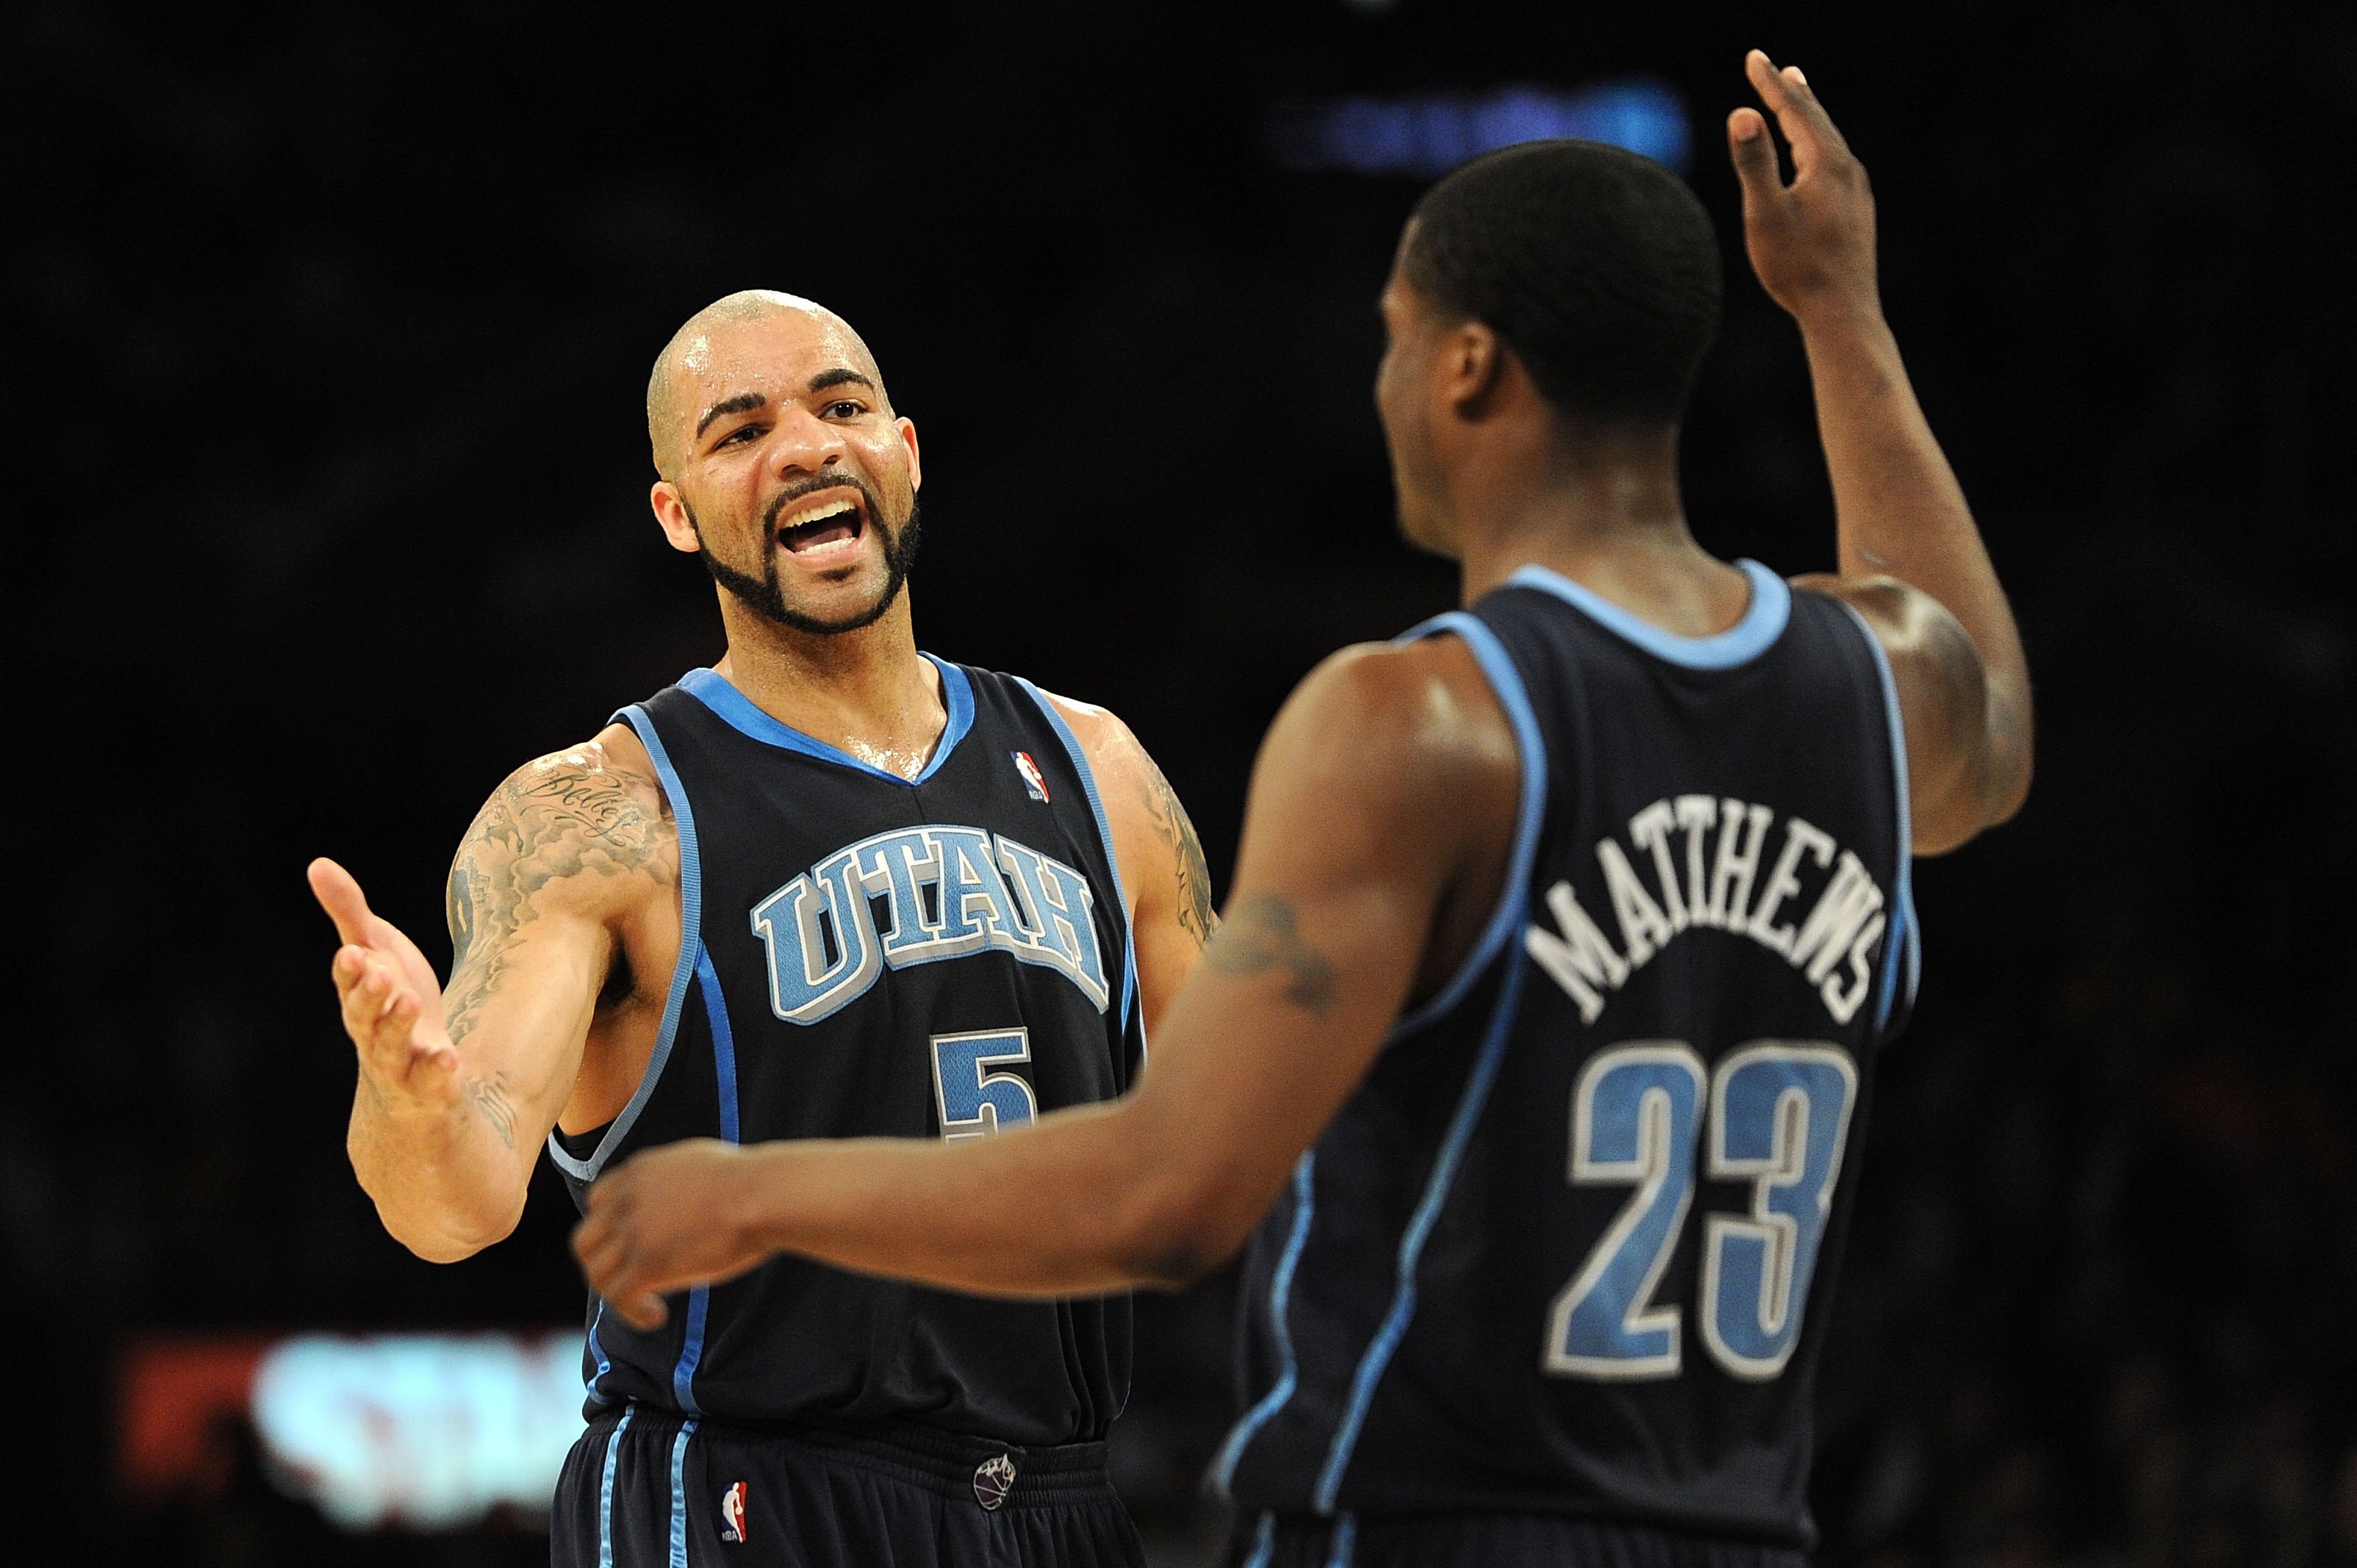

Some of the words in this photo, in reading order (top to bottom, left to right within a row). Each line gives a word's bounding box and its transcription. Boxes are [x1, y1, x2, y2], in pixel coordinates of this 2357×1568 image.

[750, 824, 1110, 1026] UTAH
[1526, 794, 1885, 1024] MATTHEWS
[930, 1026, 1038, 1140] 5
[1544, 1040, 1859, 1380] 23
[722, 1531, 738, 1542] NBA
